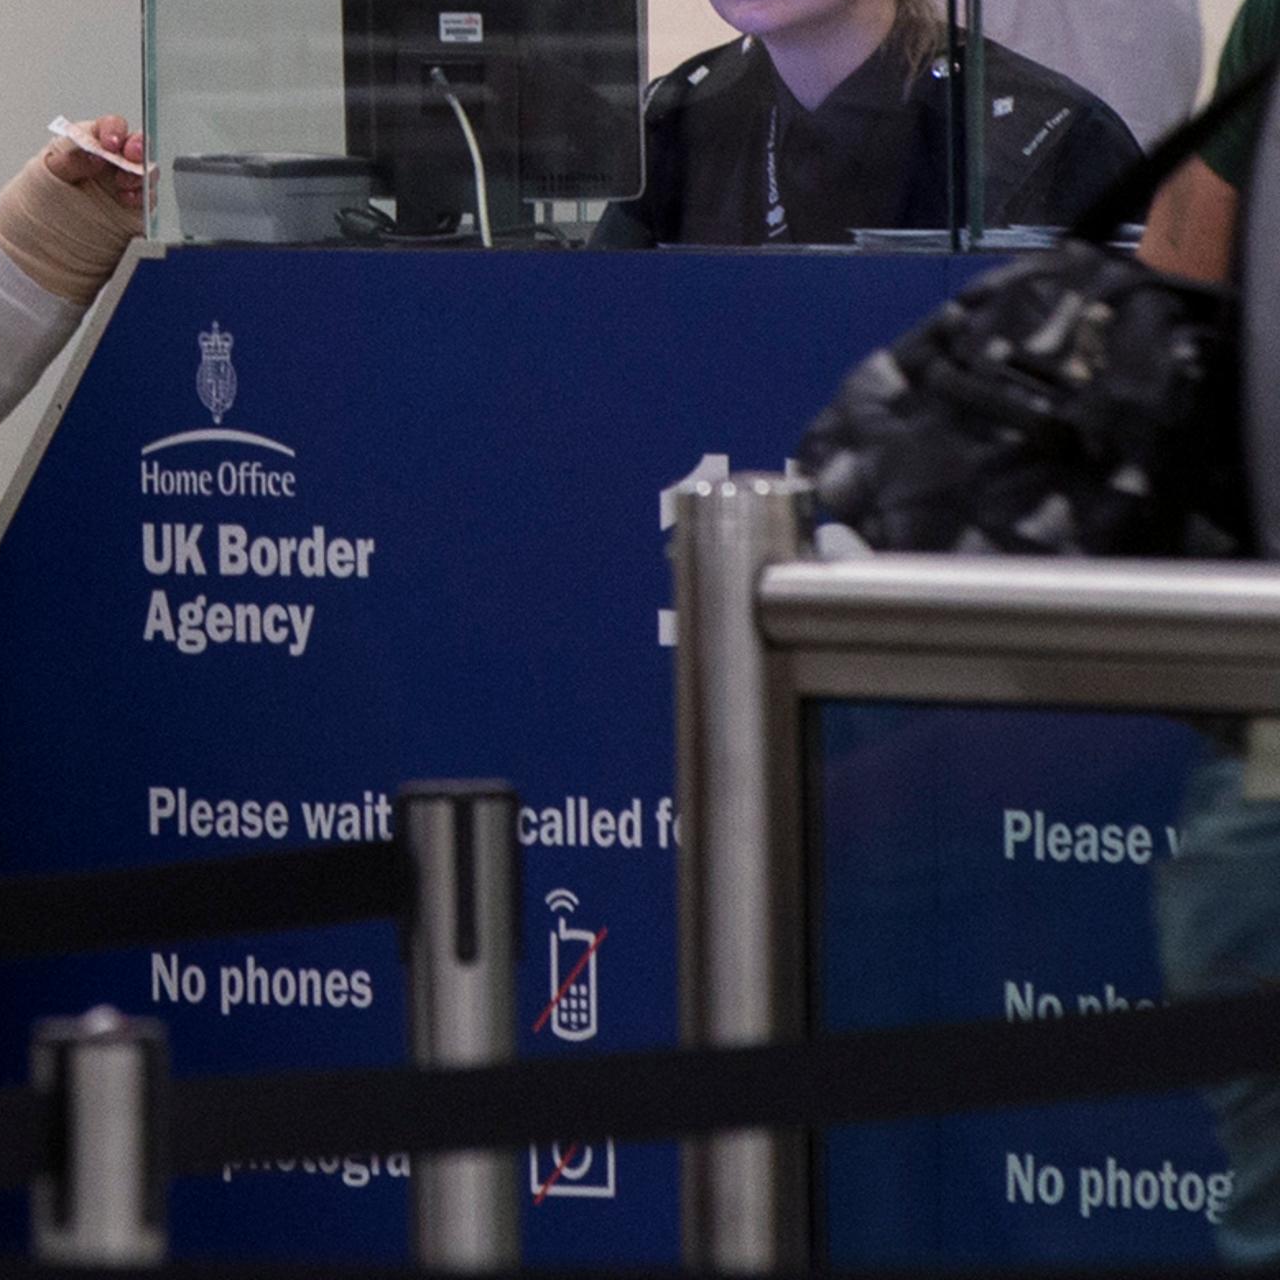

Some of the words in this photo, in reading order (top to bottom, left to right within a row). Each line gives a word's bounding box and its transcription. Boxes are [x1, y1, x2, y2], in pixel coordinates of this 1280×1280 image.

[140, 460, 213, 496] Home
[217, 461, 296, 497] Office
[142, 523, 207, 575] UK
[218, 524, 375, 578] Border
[143, 590, 315, 657] Agency
[148, 786, 290, 840] Please
[300, 790, 393, 842] wait
[518, 796, 643, 849] called
[1003, 808, 1154, 865] Please
[150, 952, 206, 1004] No
[220, 955, 373, 1015] phones
[1006, 1152, 1065, 1206] No
